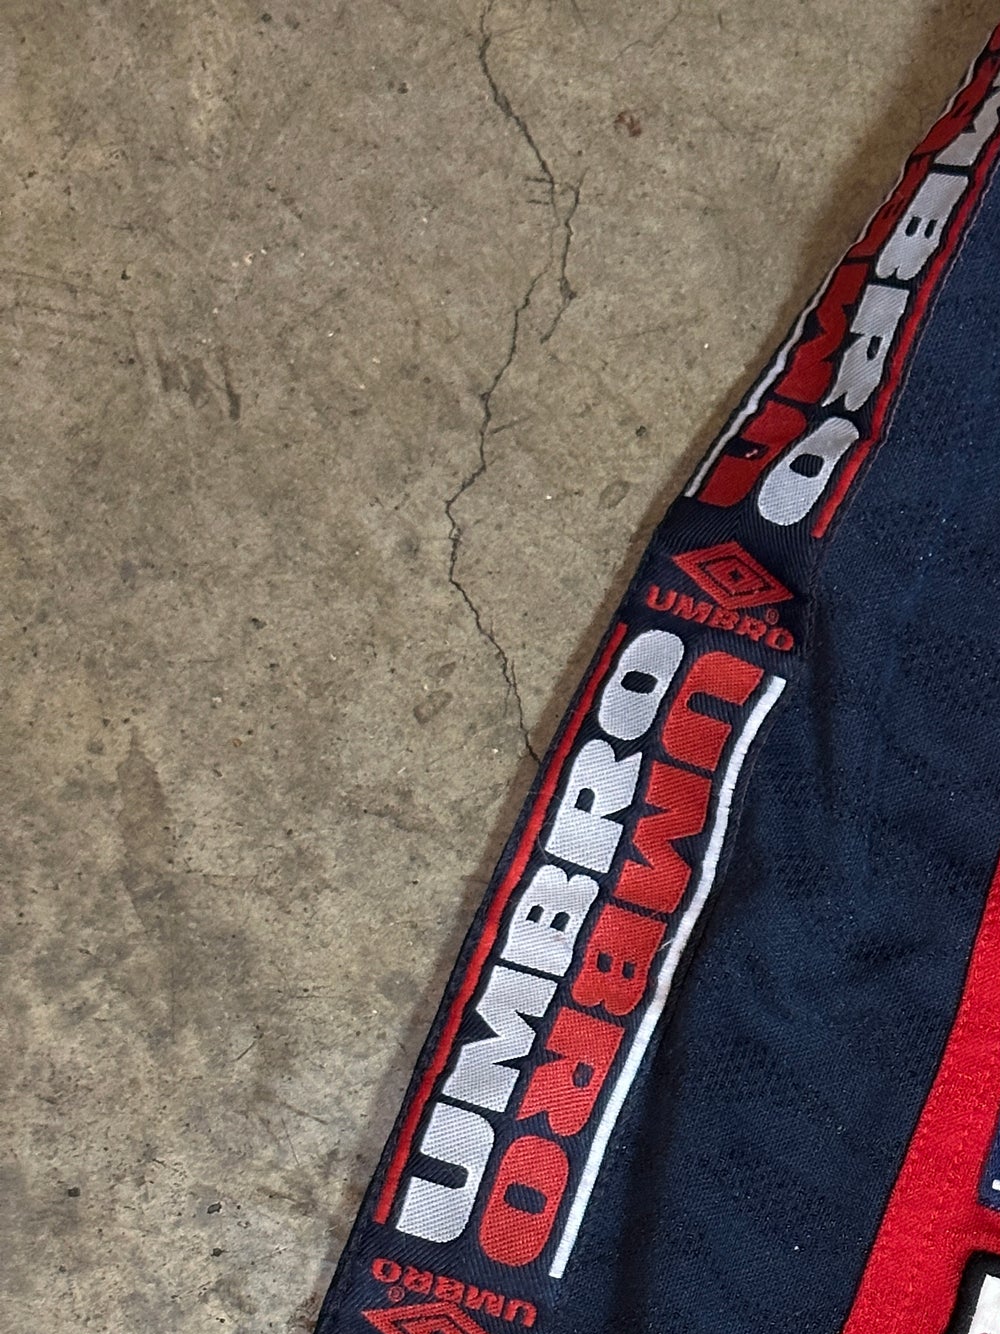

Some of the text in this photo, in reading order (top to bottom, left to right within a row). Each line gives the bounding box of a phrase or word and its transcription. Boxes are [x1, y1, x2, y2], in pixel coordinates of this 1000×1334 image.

[646, 585, 795, 651] UMBRO
[396, 630, 685, 1244] UMBRO
[480, 651, 766, 1267] UMBRO
[371, 1258, 537, 1328] UMBRO
